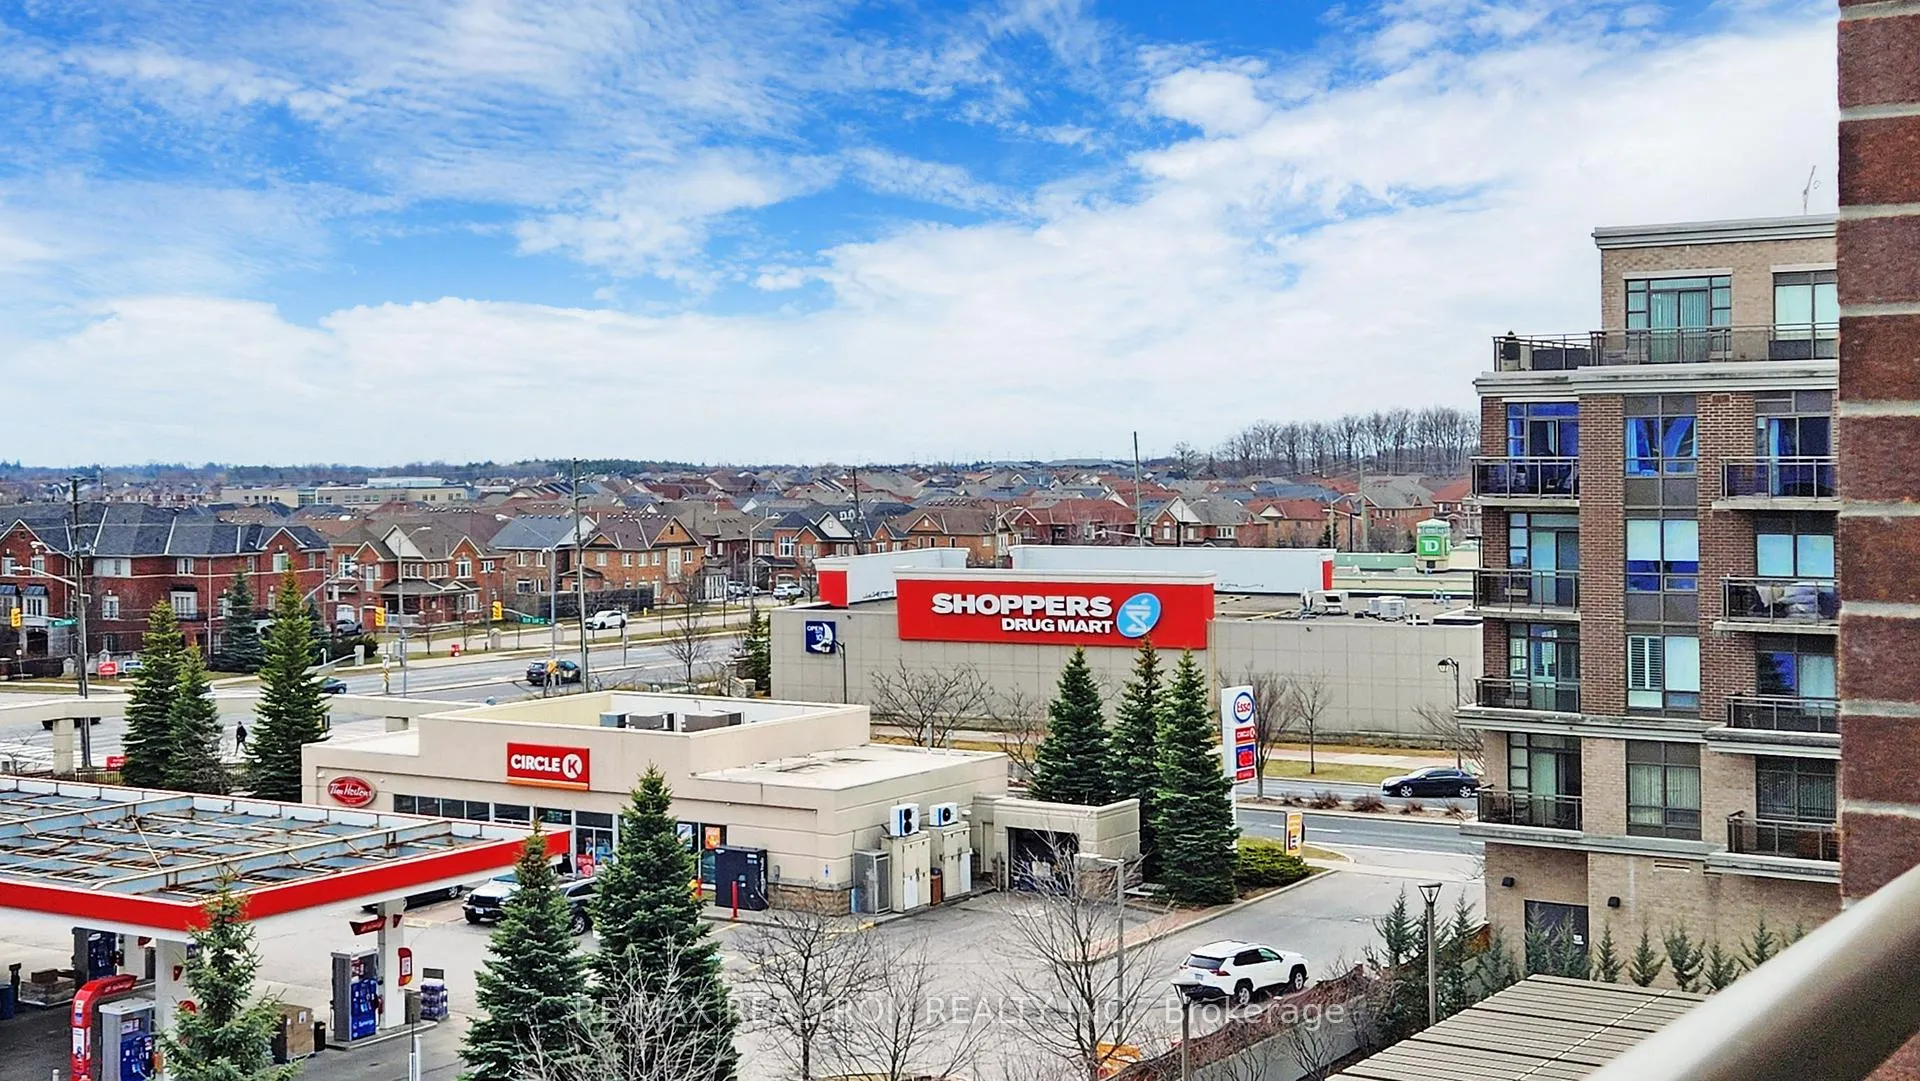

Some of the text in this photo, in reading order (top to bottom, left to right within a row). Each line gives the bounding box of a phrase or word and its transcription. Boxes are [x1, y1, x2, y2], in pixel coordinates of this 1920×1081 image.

[1420, 539, 1440, 552] TD
[931, 593, 1113, 618] SHOPPERS
[1002, 618, 1114, 634] DRUG MART
[1237, 702, 1251, 713] Esso
[511, 754, 561, 773] CIRCLE
